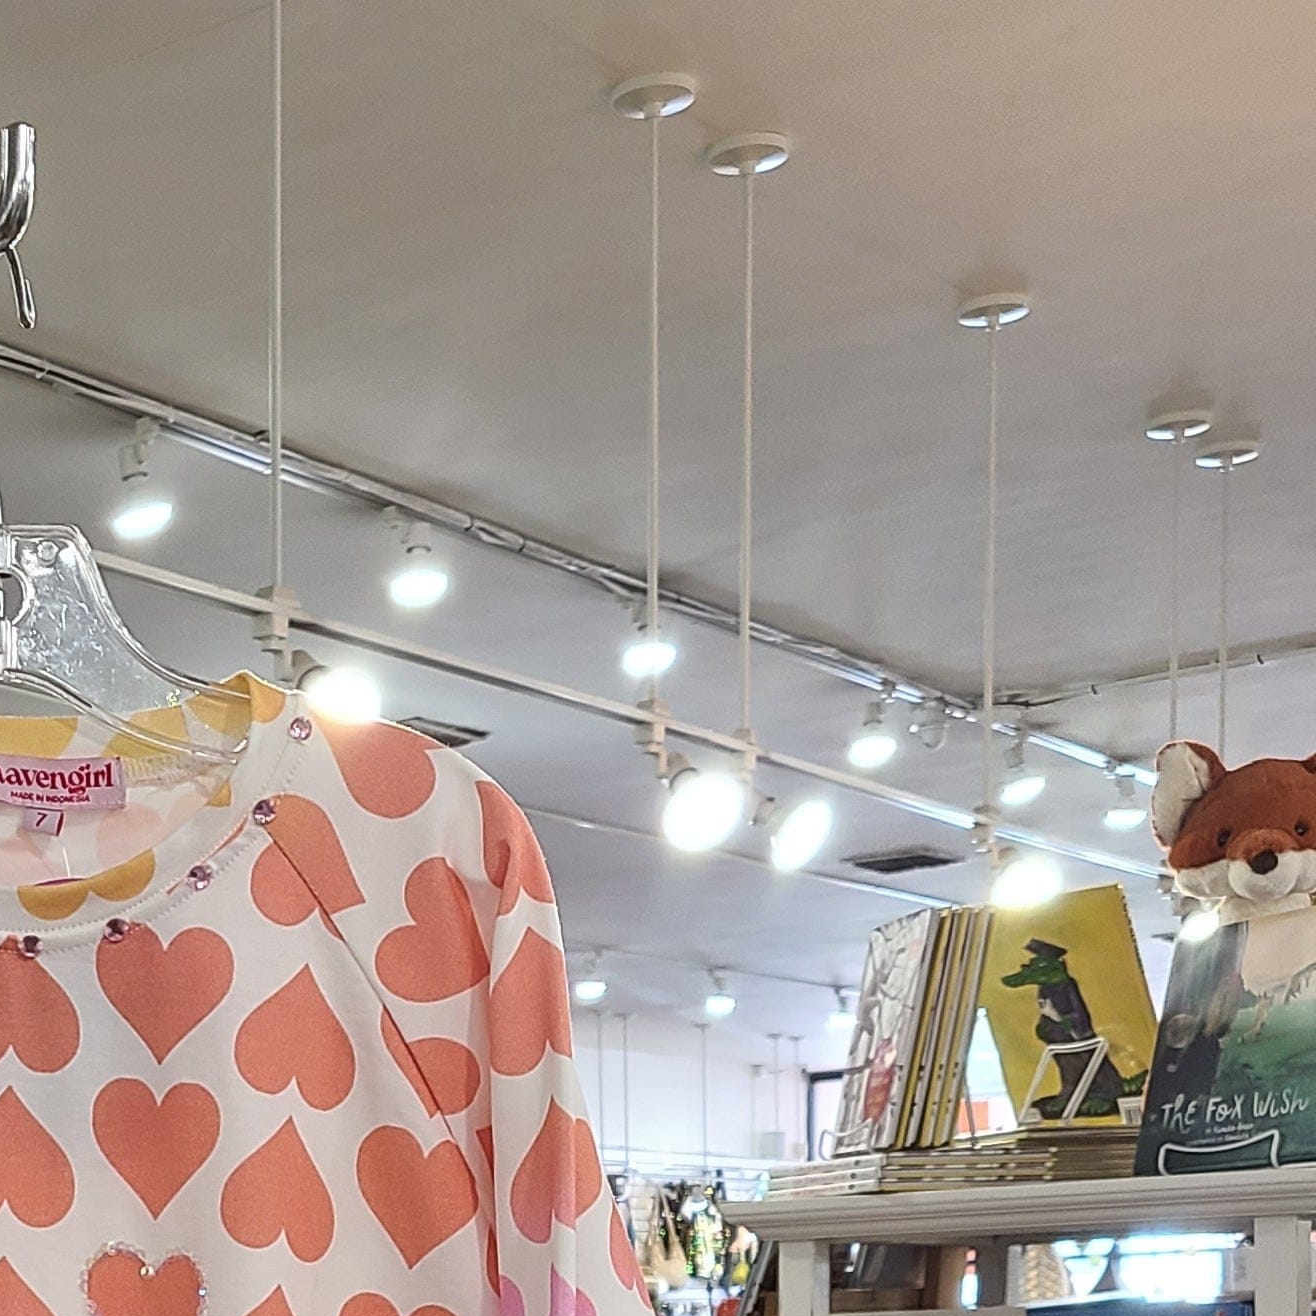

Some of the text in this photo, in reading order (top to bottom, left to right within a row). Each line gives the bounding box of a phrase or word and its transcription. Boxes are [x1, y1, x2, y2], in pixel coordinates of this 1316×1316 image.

[10, 790, 90, 803] MADE IN INDONESIA
[34, 812, 48, 828] 7
